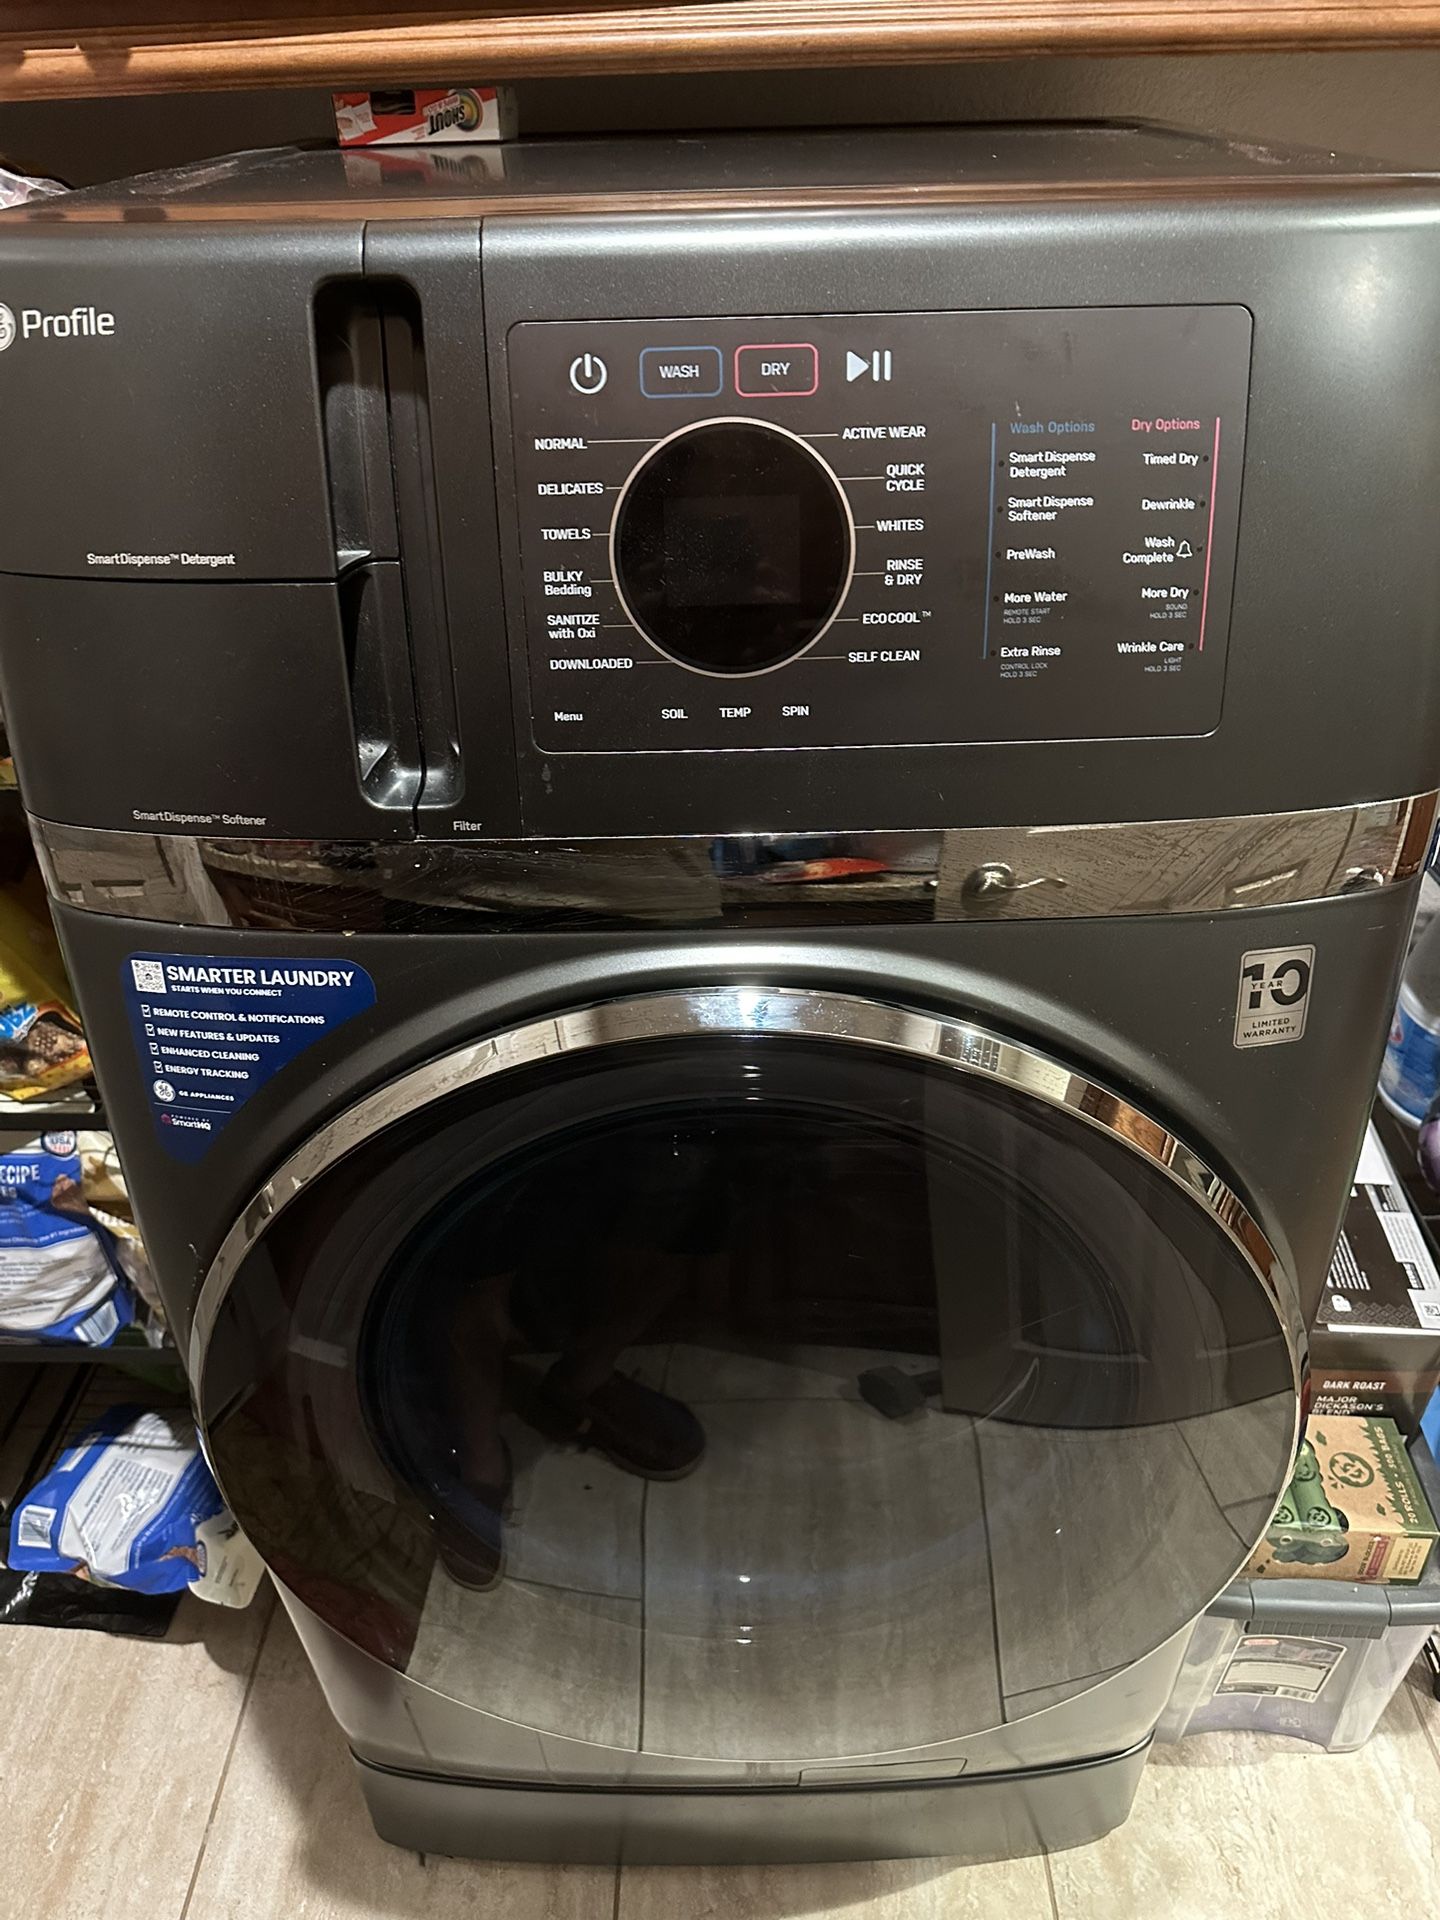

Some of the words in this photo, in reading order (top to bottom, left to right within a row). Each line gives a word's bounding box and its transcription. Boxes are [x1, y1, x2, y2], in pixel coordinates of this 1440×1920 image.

[429, 106, 465, 136] SHOUT
[22, 307, 115, 338] Profile
[659, 365, 699, 378] WASH
[761, 363, 790, 376] DRY
[1010, 422, 1043, 434] Wash
[1048, 420, 1095, 434] Options
[1131, 419, 1152, 432] Dry
[1156, 418, 1200, 432] Options
[842, 427, 887, 439] ACTIVE
[890, 426, 926, 439] WEAR
[535, 438, 587, 450] NORMAL
[1009, 451, 1044, 463] Smart
[1044, 450, 1096, 464] Dispense
[1143, 453, 1176, 465] Timed
[1178, 453, 1198, 466] Dry
[886, 464, 924, 477] QUICK
[1010, 466, 1066, 479] Detergent
[538, 483, 603, 495] DELICATES
[886, 479, 924, 492] CYCLE
[1008, 496, 1041, 509] Smart
[1043, 496, 1094, 508] Dispense
[1142, 499, 1195, 510] Dewrinkle
[1008, 510, 1058, 522] Softener
[877, 520, 924, 532] WHITES
[541, 528, 591, 540] TOWELS
[1145, 536, 1175, 548] Wash
[181, 554, 235, 567] Detergent
[1006, 548, 1056, 561] PreWash
[1123, 551, 1174, 565] Complete
[886, 559, 923, 571] RINSE
[544, 571, 583, 583] BULKY
[884, 575, 894, 585] &
[897, 574, 922, 586] DRY
[545, 584, 592, 597] Bedding
[1142, 588, 1167, 598] More
[1170, 587, 1189, 599] Dry
[1004, 592, 1031, 604] More
[1034, 591, 1067, 603] Water
[1004, 608, 1029, 616] REMOTE
[547, 614, 600, 626] SANITIZE
[1003, 616, 1021, 624] HOLD
[549, 627, 574, 640] with
[577, 628, 596, 639] Oxi
[1001, 646, 1029, 657] Extra
[1031, 645, 1061, 657] Rinse
[1117, 641, 1156, 653] Wrinkle
[1159, 641, 1184, 651] Care
[848, 651, 878, 663] SELF
[880, 650, 920, 662] CLEAN
[550, 658, 633, 670] DOWNLOADED
[1144, 665, 1161, 673] HOLD
[554, 711, 583, 722] Menu
[661, 708, 688, 720] SOIL
[720, 707, 751, 719] TEMP
[782, 706, 809, 717] SPIN
[223, 815, 267, 825] Softener
[453, 819, 482, 832] Filter
[167, 966, 256, 985] SMARTER
[261, 969, 354, 988] LAUNDRY
[1242, 959, 1310, 1010] 10
[1251, 979, 1283, 990] YEAR
[171, 986, 199, 994] STARTS
[200, 987, 224, 995] WHEN
[225, 988, 242, 996] YOU
[243, 989, 282, 997] CONNECT
[153, 1008, 190, 1019] REMOTE
[191, 1011, 236, 1022] CONTROL
[238, 1013, 247, 1022] &
[248, 1013, 325, 1024] NOTIFICATIONS
[1252, 1017, 1290, 1029] LIMITED
[157, 1027, 178, 1037] NEW
[179, 1029, 225, 1040] FEATURES
[226, 1032, 235, 1041] &
[236, 1033, 280, 1043] UPDATES
[1243, 1025, 1297, 1038] WARRANTY
[161, 1046, 211, 1058] ENHANCED
[211, 1050, 260, 1061] CLEANING
[165, 1065, 199, 1075] ENERGY
[200, 1068, 249, 1079] TRACKING
[190, 1092, 234, 1101] APPLIANCES
[171, 1118, 211, 1130] SmartHQ
[1323, 1380, 1351, 1389] DARK
[1353, 1381, 1386, 1390] ROAST
[1314, 1402, 1384, 1411] DICKASON'S
[1374, 1426, 1391, 1451] BAGS
